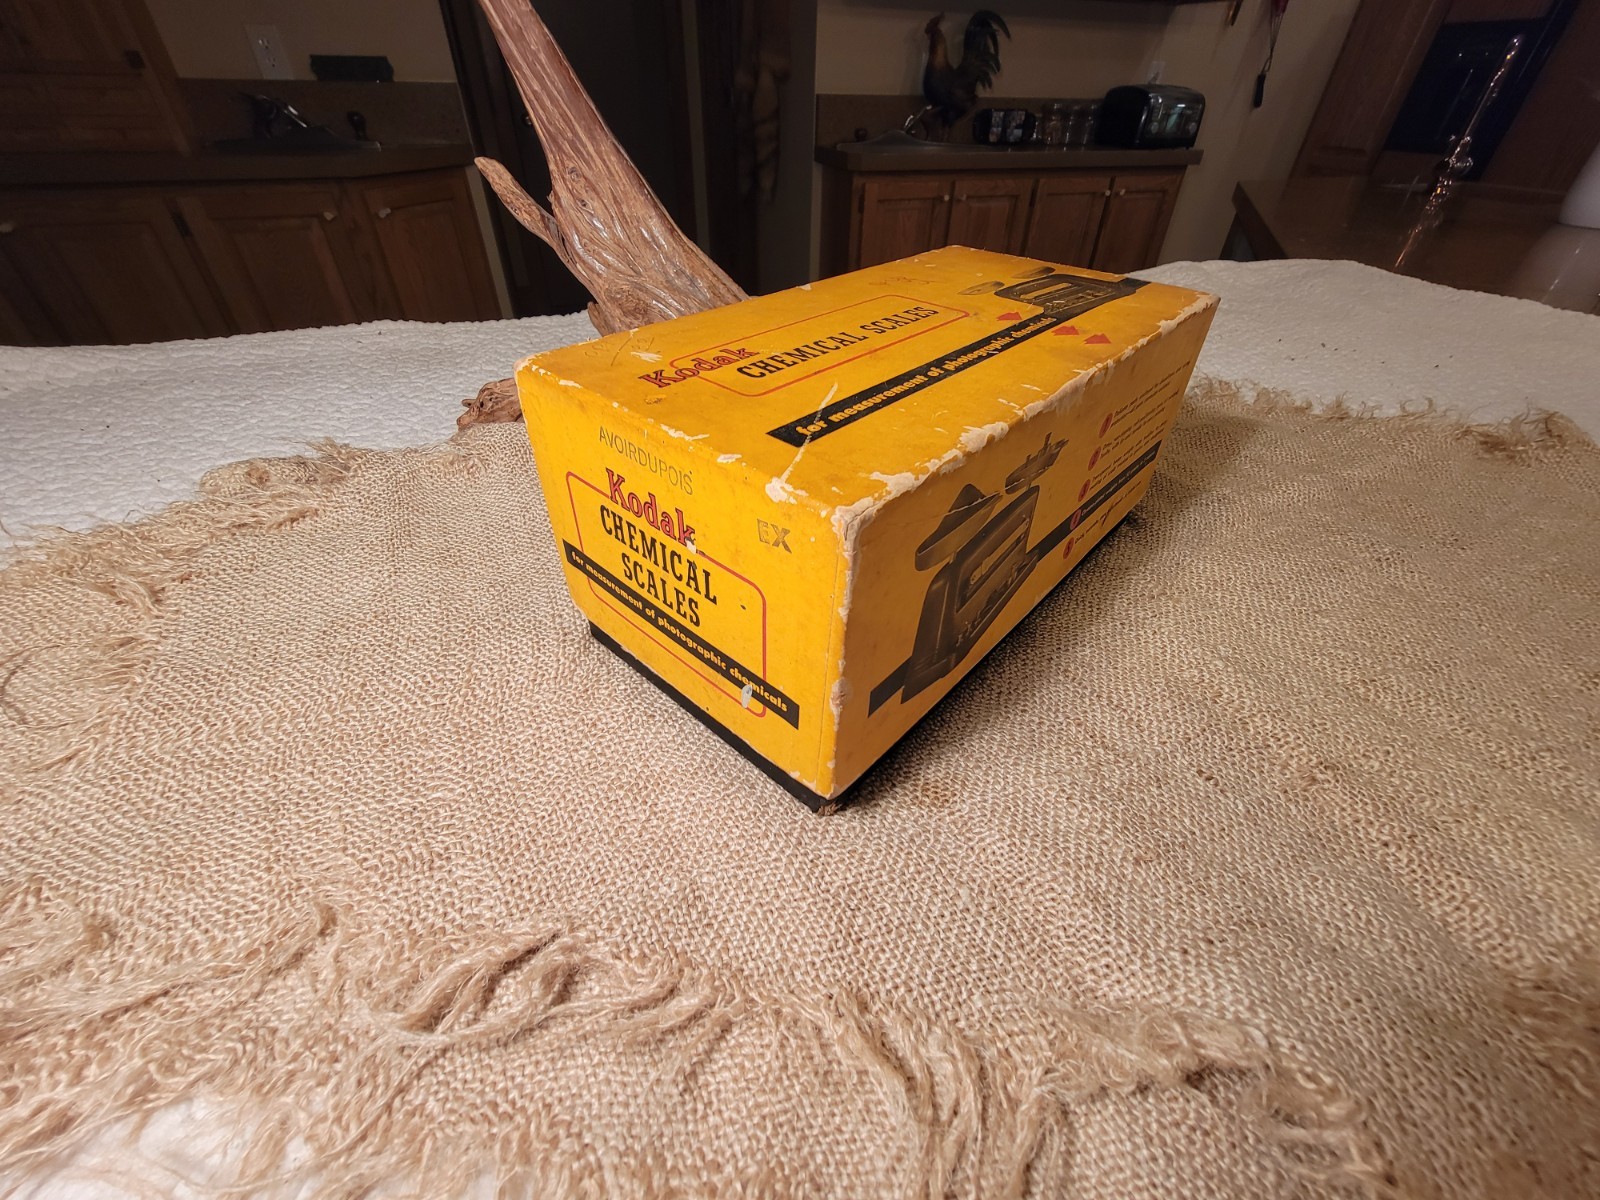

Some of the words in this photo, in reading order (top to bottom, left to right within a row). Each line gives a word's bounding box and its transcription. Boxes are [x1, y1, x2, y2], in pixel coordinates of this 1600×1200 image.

[638, 346, 760, 388] Kodak
[736, 331, 870, 378] CHEMICAL
[860, 306, 939, 334] SCALES
[796, 419, 828, 436] for
[828, 373, 929, 422] measurement
[927, 366, 945, 378] of
[942, 336, 1015, 371] photographic
[1010, 317, 1057, 339] chemicals
[598, 425, 694, 496] AVOIRDUPOIS
[606, 467, 696, 547] Kodak
[756, 518, 793, 555] EX
[600, 504, 718, 606] CHEMICAL
[621, 552, 701, 628] SCALES
[571, 551, 585, 566] for
[585, 564, 643, 611] measurement
[645, 607, 656, 620] of
[657, 614, 728, 671] photographic
[729, 666, 789, 713] chemicals
